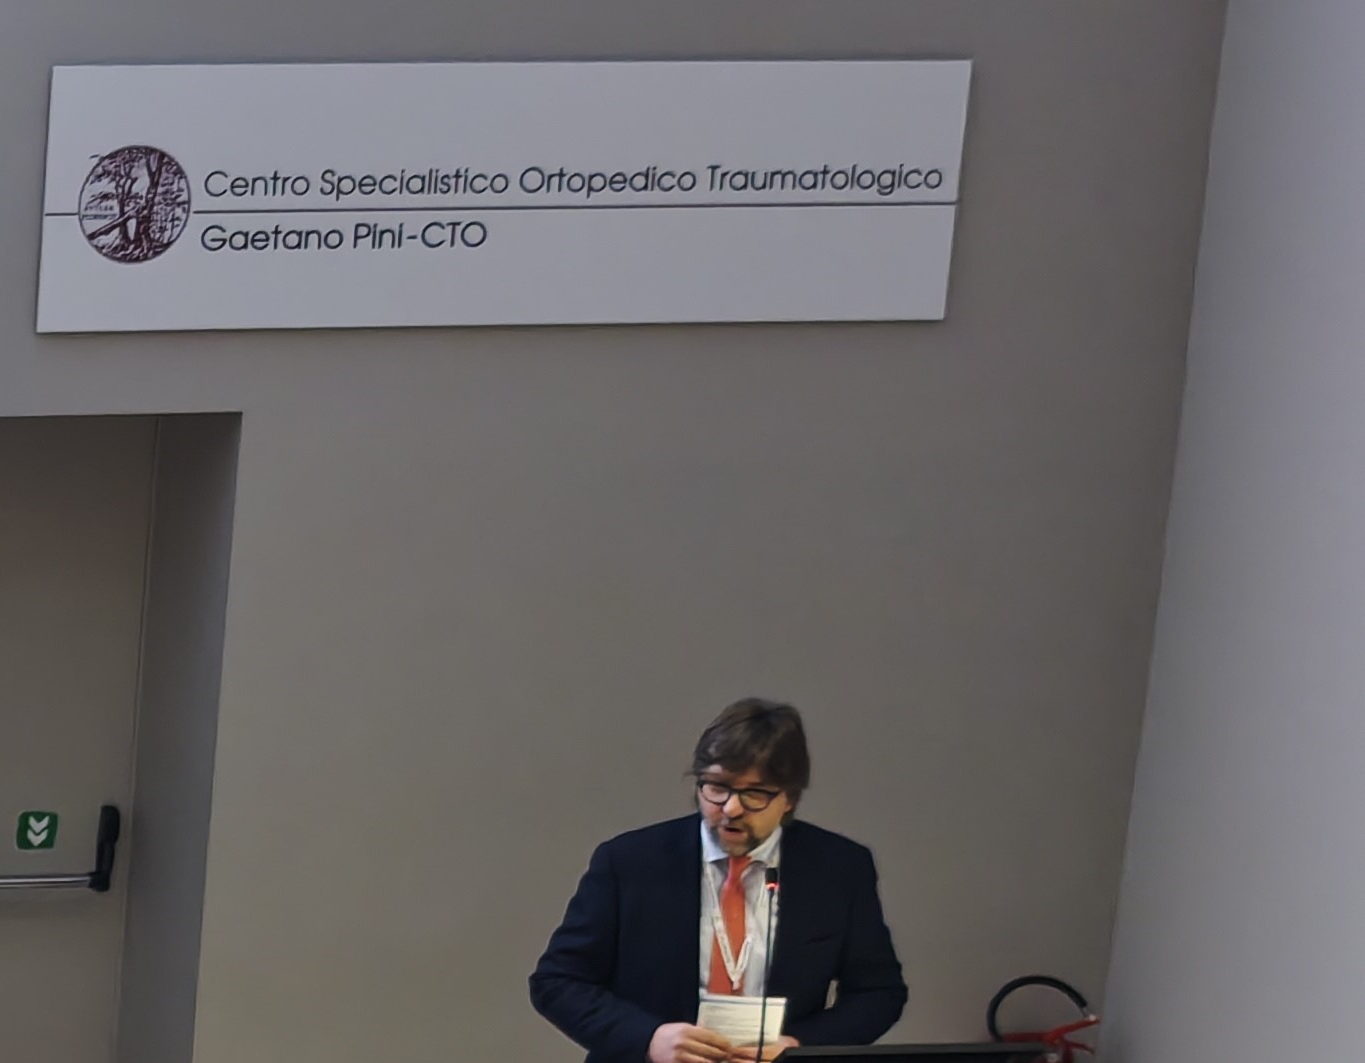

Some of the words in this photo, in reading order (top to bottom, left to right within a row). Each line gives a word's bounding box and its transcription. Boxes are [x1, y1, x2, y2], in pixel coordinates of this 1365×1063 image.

[203, 169, 311, 198] Centro
[319, 167, 510, 202] Specialistico
[518, 165, 697, 200] Ortopedico
[706, 163, 944, 195] Traumatologico
[200, 223, 345, 252] Gaetano
[352, 220, 489, 250] Pini-CTO
